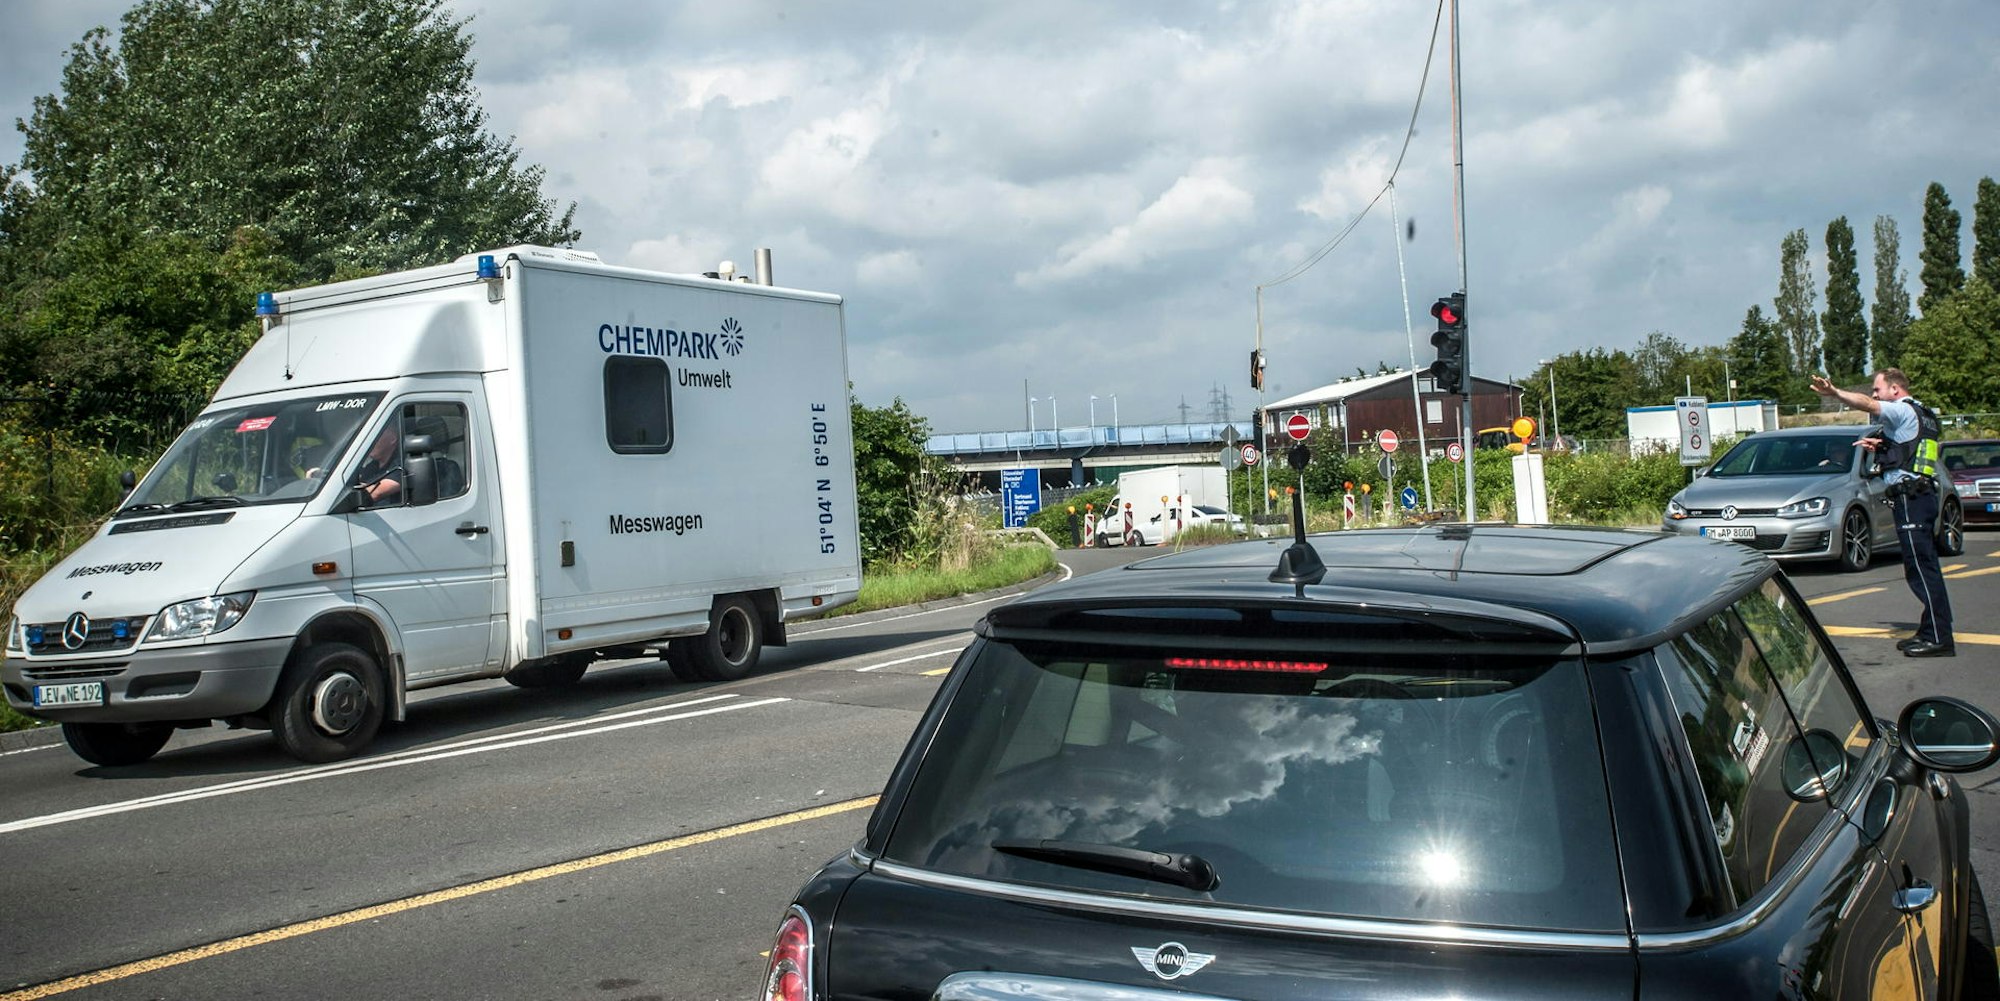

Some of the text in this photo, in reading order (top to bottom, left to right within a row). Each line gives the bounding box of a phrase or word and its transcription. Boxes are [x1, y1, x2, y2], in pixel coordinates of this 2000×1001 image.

[598, 324, 719, 360] CHEMPARK
[678, 368, 732, 388] Umwelt
[1246, 450, 1254, 460] 40
[1452, 448, 1459, 456] 40
[811, 403, 835, 553] 51°04' N 6°50' E
[609, 514, 703, 536] Messwagen
[1721, 529, 1732, 537] AP
[1733, 529, 1754, 537] 8000
[66, 561, 163, 580] Messwagen
[41, 684, 102, 704] LEV NE 192
[1156, 954, 1184, 966] MINI
